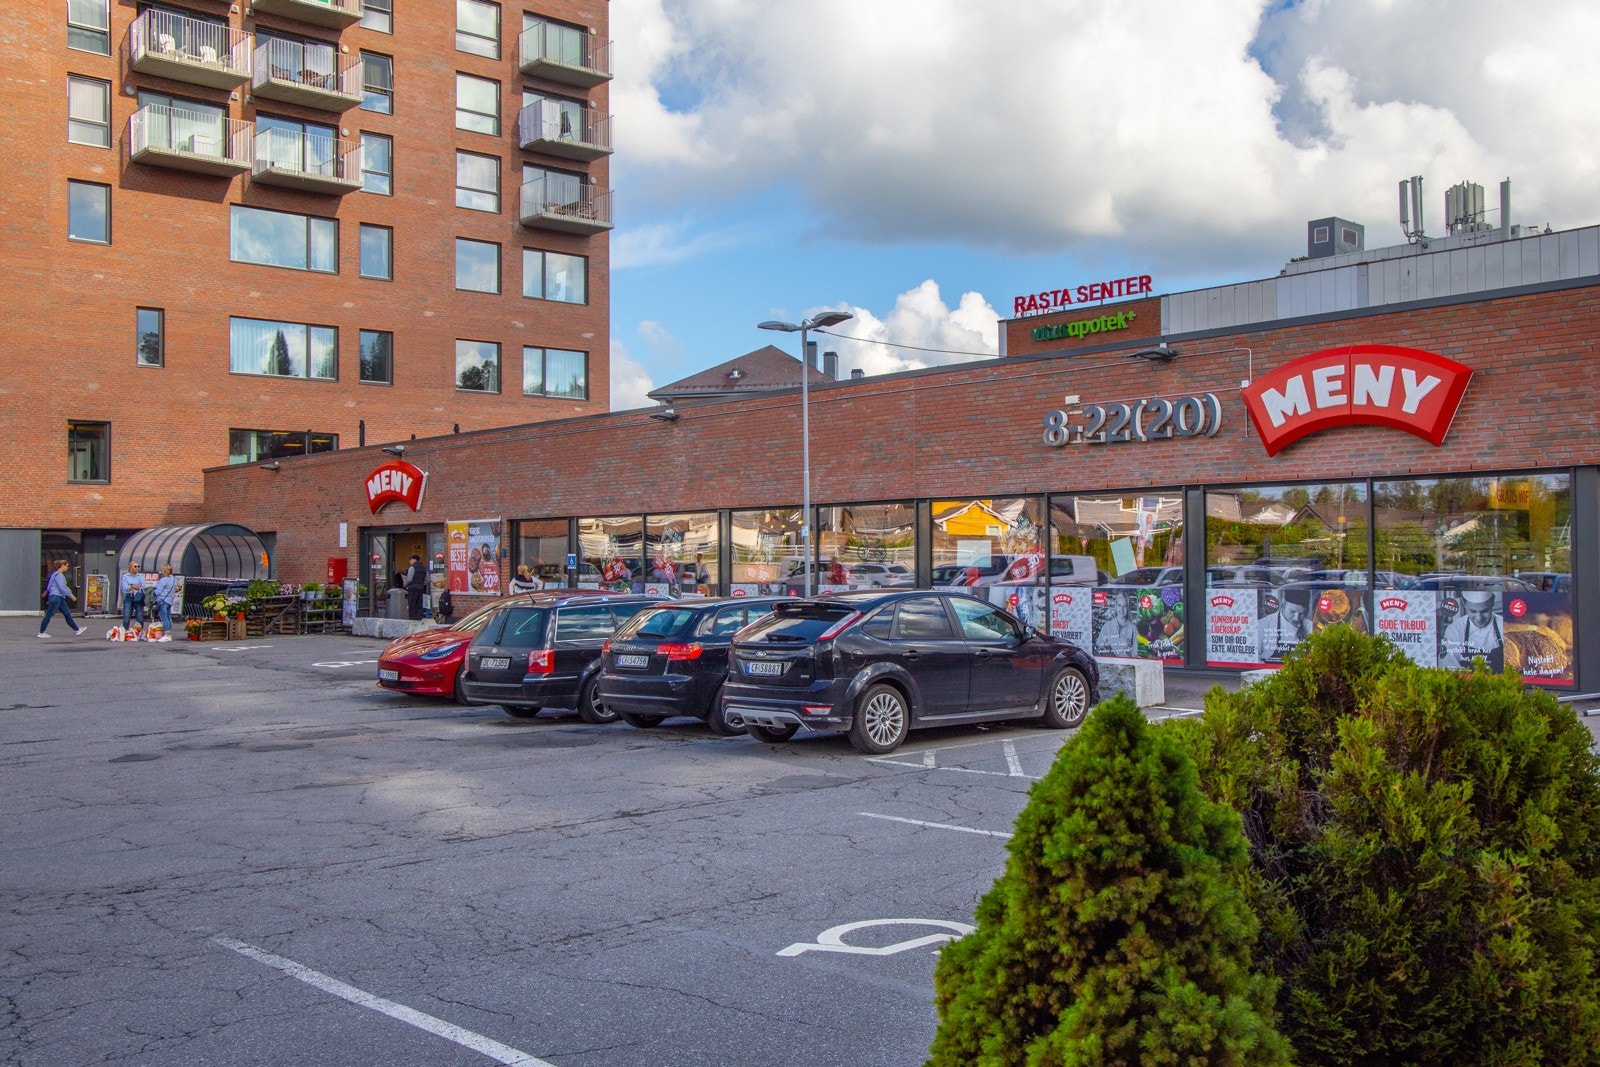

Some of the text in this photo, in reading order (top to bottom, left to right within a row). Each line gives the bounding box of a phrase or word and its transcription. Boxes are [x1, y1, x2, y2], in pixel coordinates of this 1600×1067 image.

[1014, 274, 1153, 313] RASTA SENTER
[1261, 364, 1442, 428] MENY
[367, 469, 413, 500] MENY
[1496, 488, 1518, 503] GRATIS
[450, 549, 466, 561] BESTE
[1382, 599, 1406, 608] MENY
[1052, 609, 1059, 618] ET
[1052, 620, 1069, 629] BREDT
[1211, 615, 1249, 624] KUNNSKAP OG
[1378, 619, 1426, 631] GODE TILBUD
[1060, 631, 1082, 640] VARIERT
[1211, 626, 1242, 634] LIDENSKAP
[1211, 635, 1247, 645] SOM GIR DEG
[1391, 632, 1422, 643] SMARTE
[1211, 645, 1256, 654] EKTE MATGLEDE
[1528, 655, 1555, 668] Nystekt
[1523, 666, 1564, 678] hele dagen!
